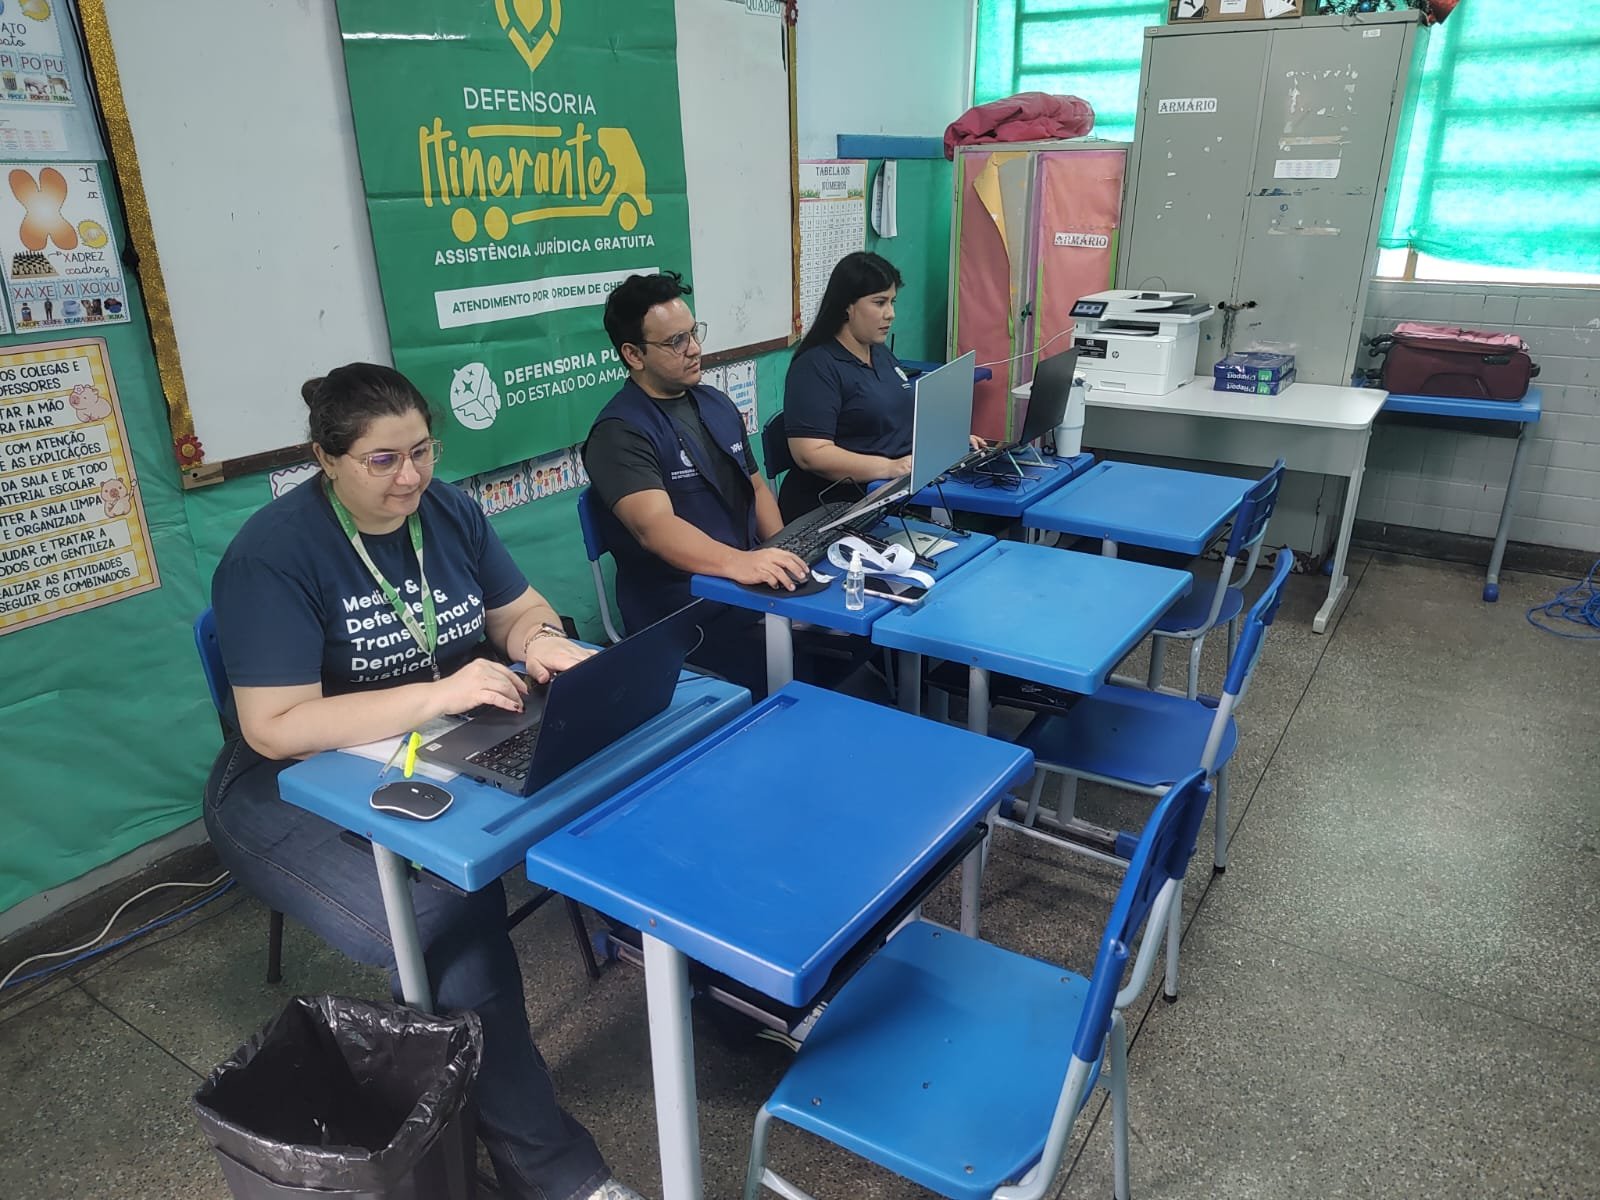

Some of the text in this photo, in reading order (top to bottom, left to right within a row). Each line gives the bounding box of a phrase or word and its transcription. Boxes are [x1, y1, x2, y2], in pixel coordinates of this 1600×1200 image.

[21, 56, 41, 70] PO
[45, 58, 64, 73] PU
[463, 87, 597, 115] DEFENSORIA
[419, 117, 611, 207] Itinerante
[816, 167, 840, 176] TABELA
[63, 251, 105, 264] XADREZ
[435, 233, 656, 265] ASSISTÊNCIA JURÍDICA GRATUITA
[14, 281, 120, 300] XA XE XI XO XU
[452, 293, 531, 315] ATENDIMENTO
[532, 289, 550, 302] POR
[551, 284, 586, 299] ORDEM
[588, 283, 602, 295] DE
[20, 362, 70, 379] COLEGAS
[72, 360, 81, 372] E
[504, 352, 597, 387] DEFENSORIA
[506, 388, 527, 408] DO
[529, 375, 576, 402] ESTADO
[577, 372, 597, 390] DO
[27, 404, 35, 416] A
[38, 398, 65, 413] MÃO
[19, 415, 54, 431] FALAR
[5, 430, 86, 456] COM ATENÇÃO
[11, 456, 26, 470] AS
[29, 442, 102, 466] EXPLICAÇÕES
[1, 461, 108, 492] DA SALA E DE TODO
[49, 476, 96, 496] ESCOLAR
[30, 509, 38, 520] A
[41, 503, 67, 518] SALA
[70, 495, 103, 511] LIMPA
[3, 512, 86, 540] E ORGANIZADA
[33, 553, 58, 567] COM
[61, 538, 116, 561] GENTILEZA
[40, 542, 48, 553] E
[49, 530, 96, 550] TRATAR
[99, 527, 107, 538] A
[44, 587, 60, 600] OS
[63, 567, 131, 594] COMBINADOS
[46, 573, 60, 587] AS
[63, 556, 123, 582] ATIVIDADES
[404, 579, 419, 594] &
[433, 589, 448, 603] &
[467, 594, 481, 606] &
